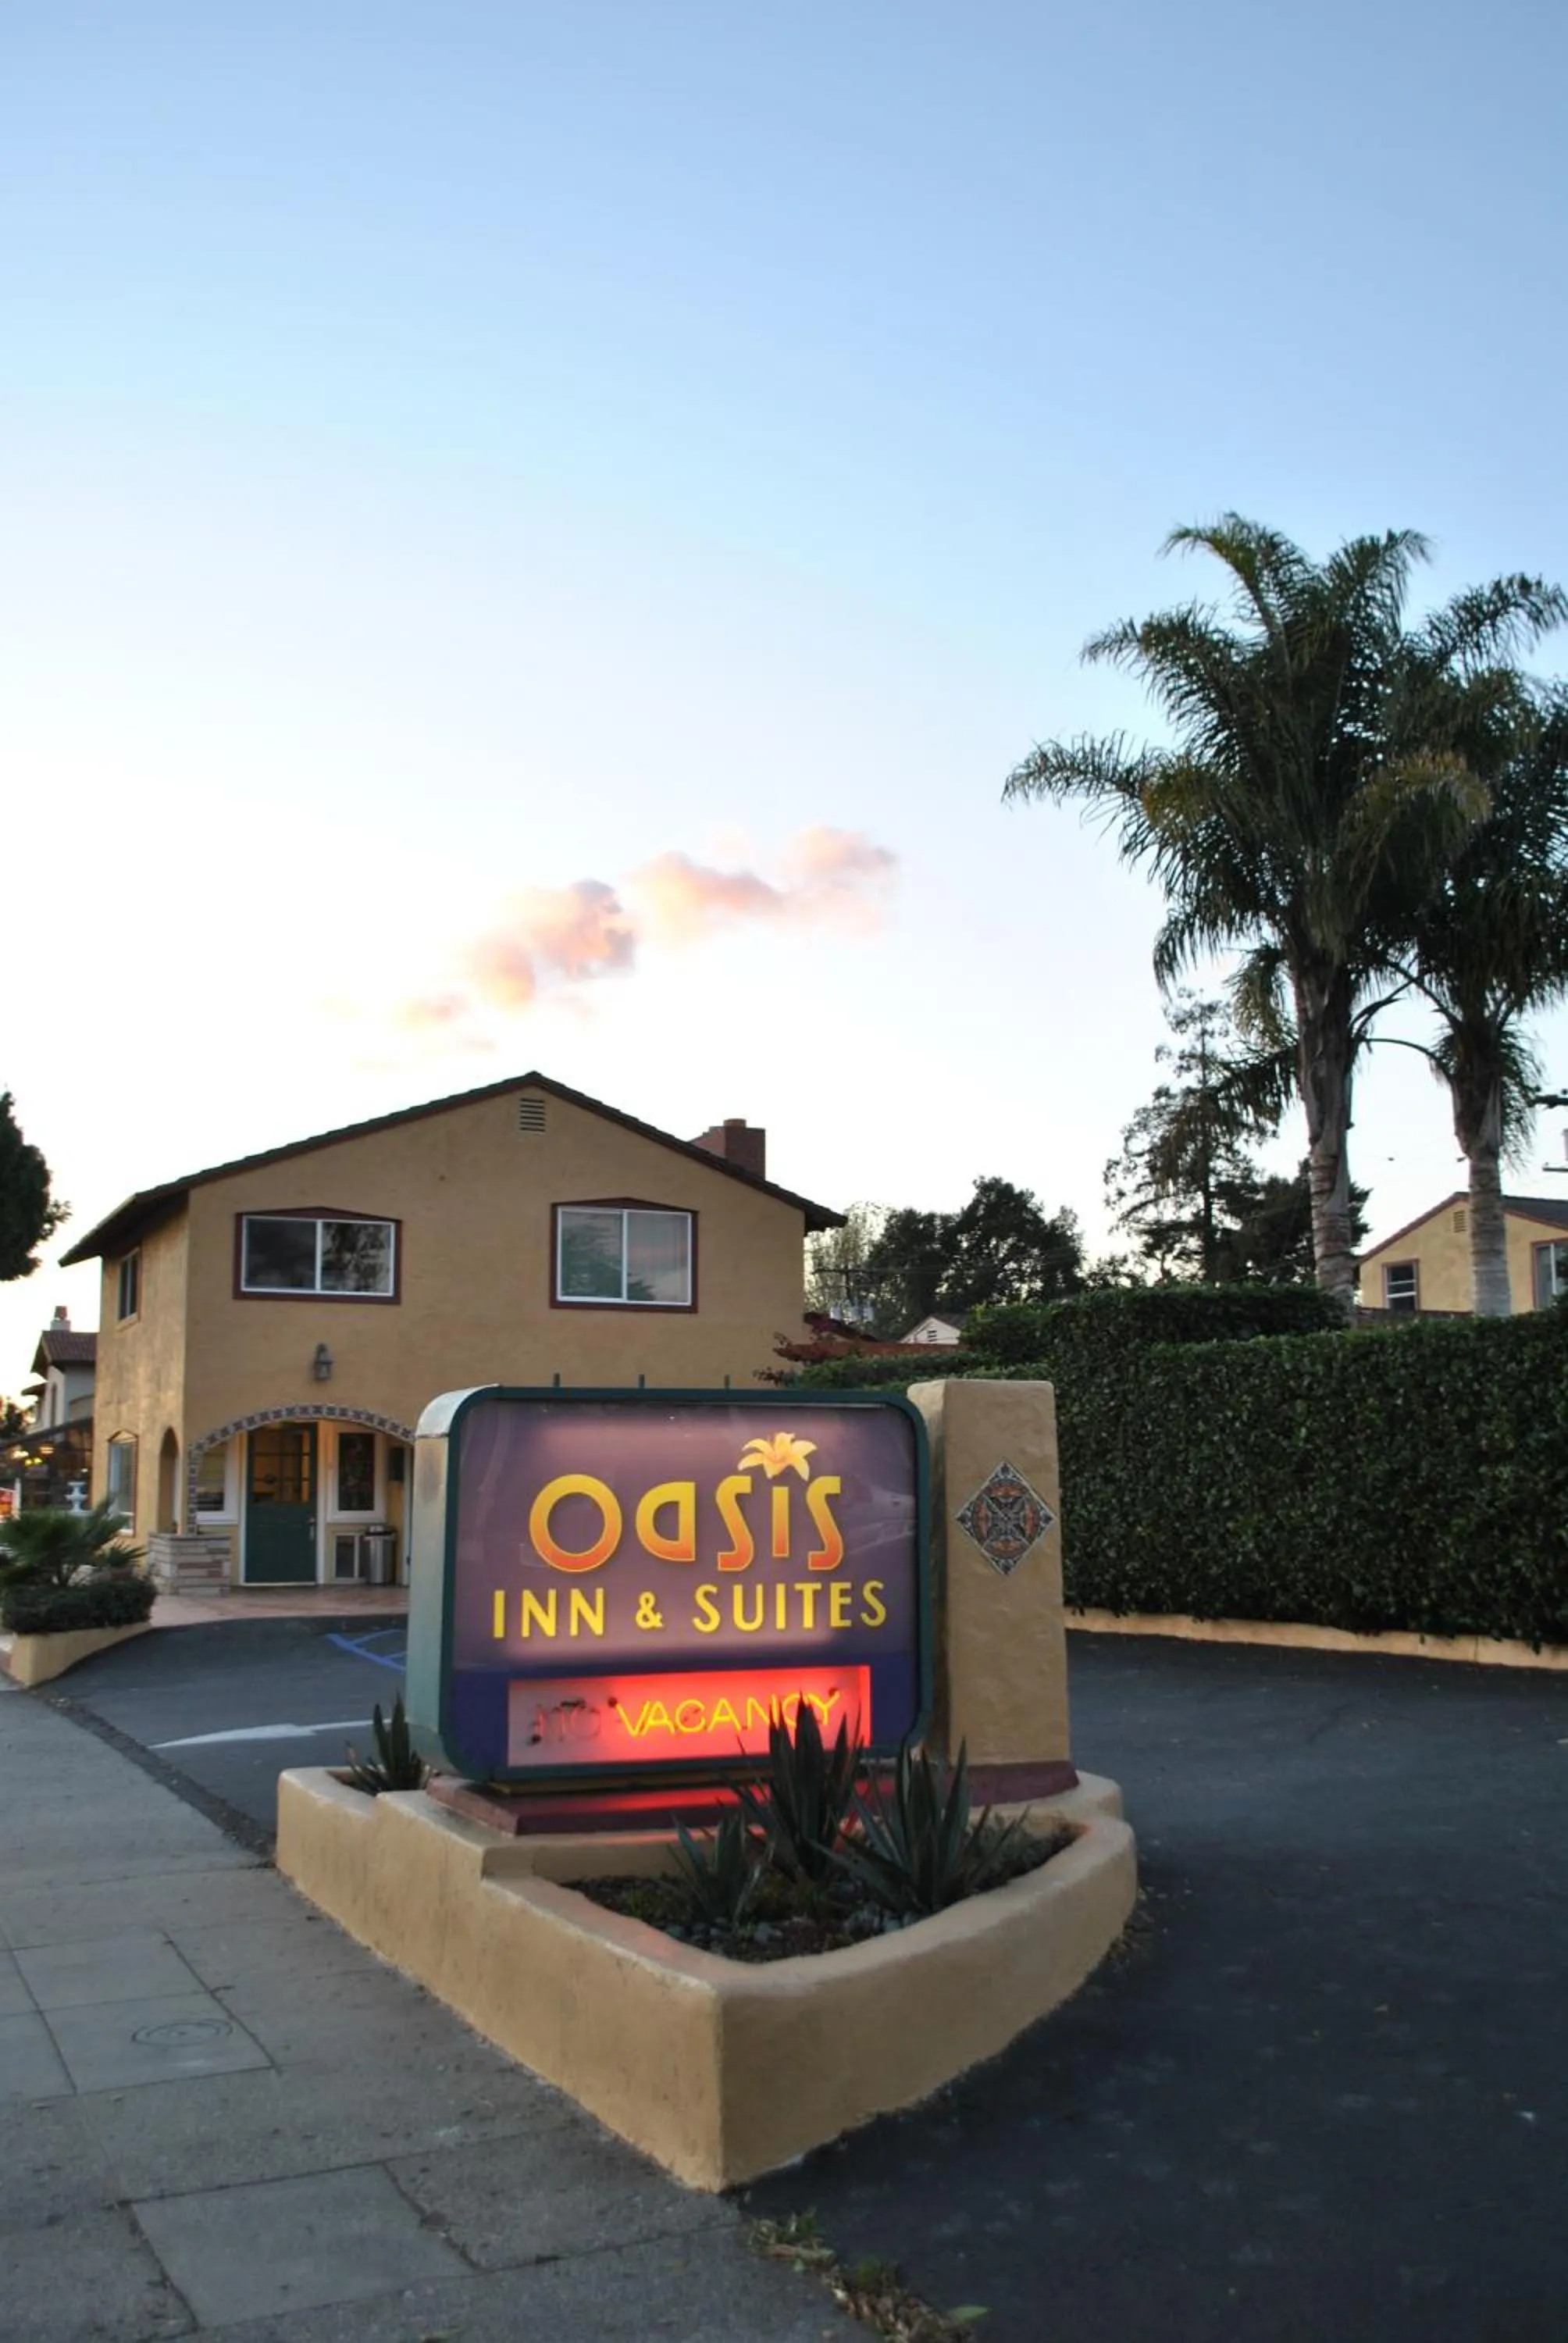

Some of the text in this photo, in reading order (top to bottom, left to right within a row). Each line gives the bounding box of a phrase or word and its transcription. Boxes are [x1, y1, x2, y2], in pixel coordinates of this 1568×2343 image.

[493, 1580, 887, 1638] INN & SUITES
[615, 1689, 841, 1737] VACANCY
